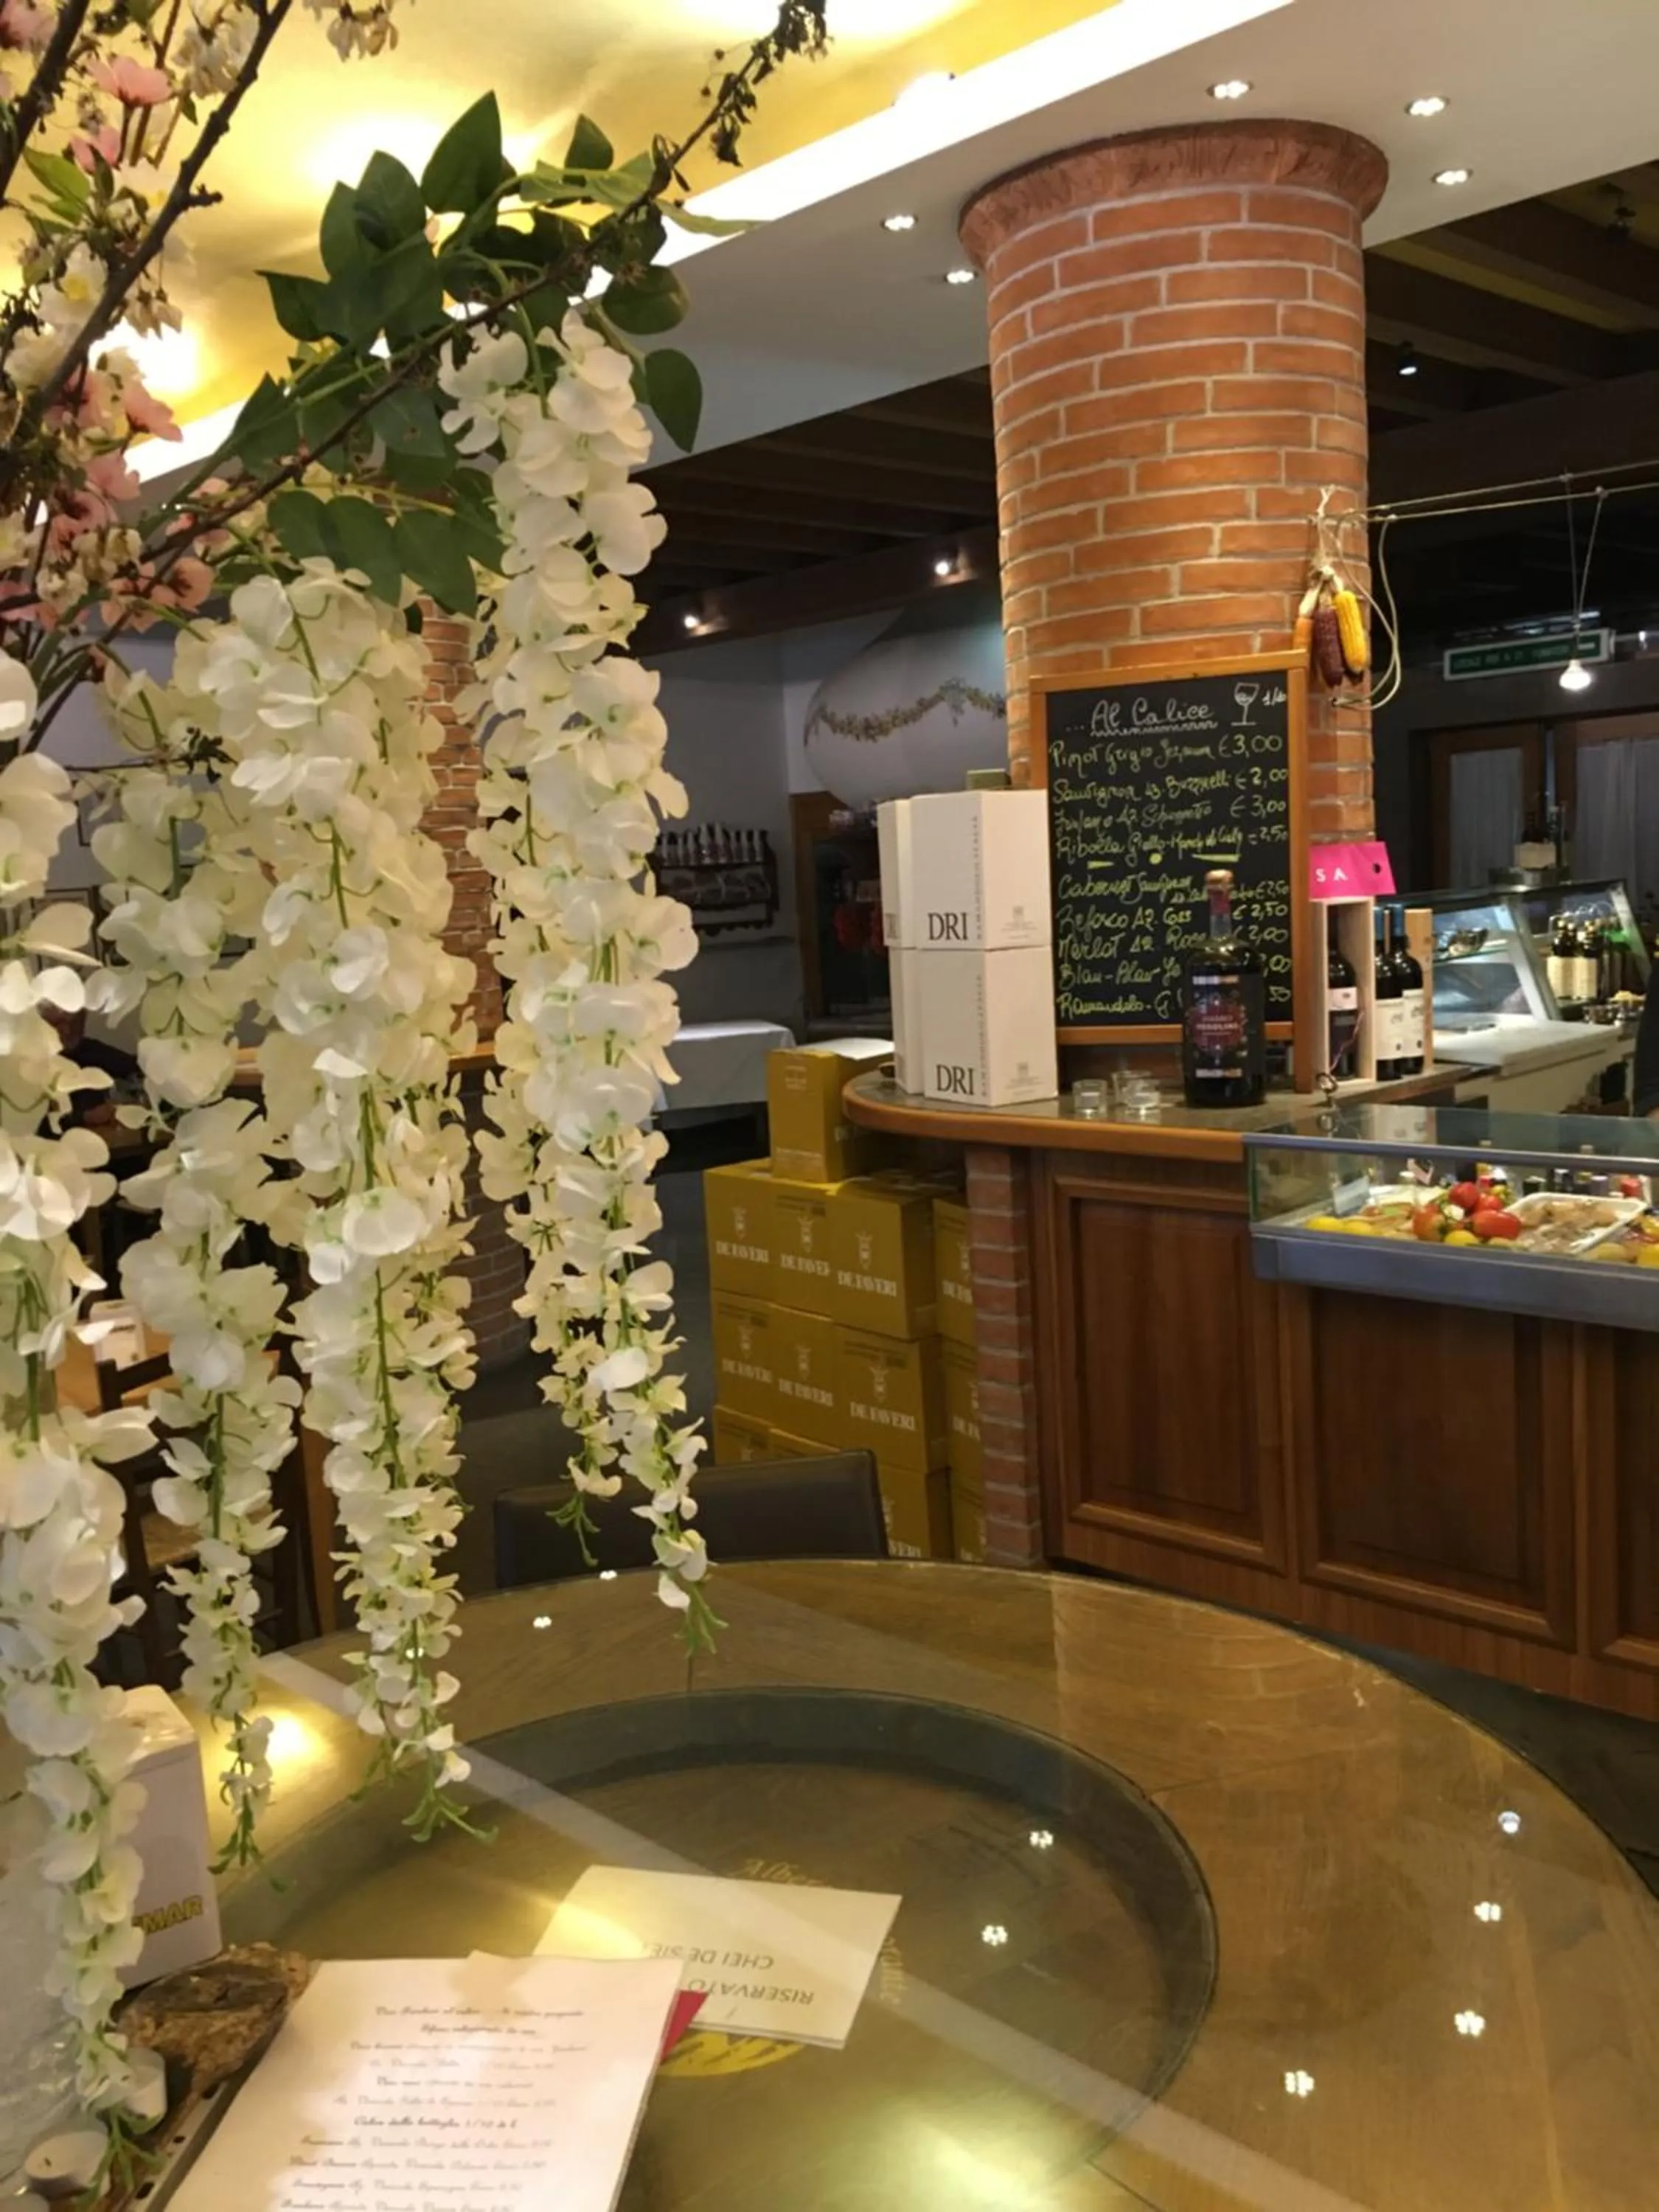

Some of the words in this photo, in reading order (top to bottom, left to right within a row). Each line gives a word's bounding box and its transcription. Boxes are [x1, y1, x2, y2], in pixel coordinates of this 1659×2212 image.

[1132, 697, 1214, 726] Calice
[927, 912, 969, 941] DRI
[936, 1063, 975, 1096] DRI
[687, 1947, 717, 1965] DE
[721, 1951, 775, 1970] CHEI
[687, 1978, 815, 2006] RISERVATO
